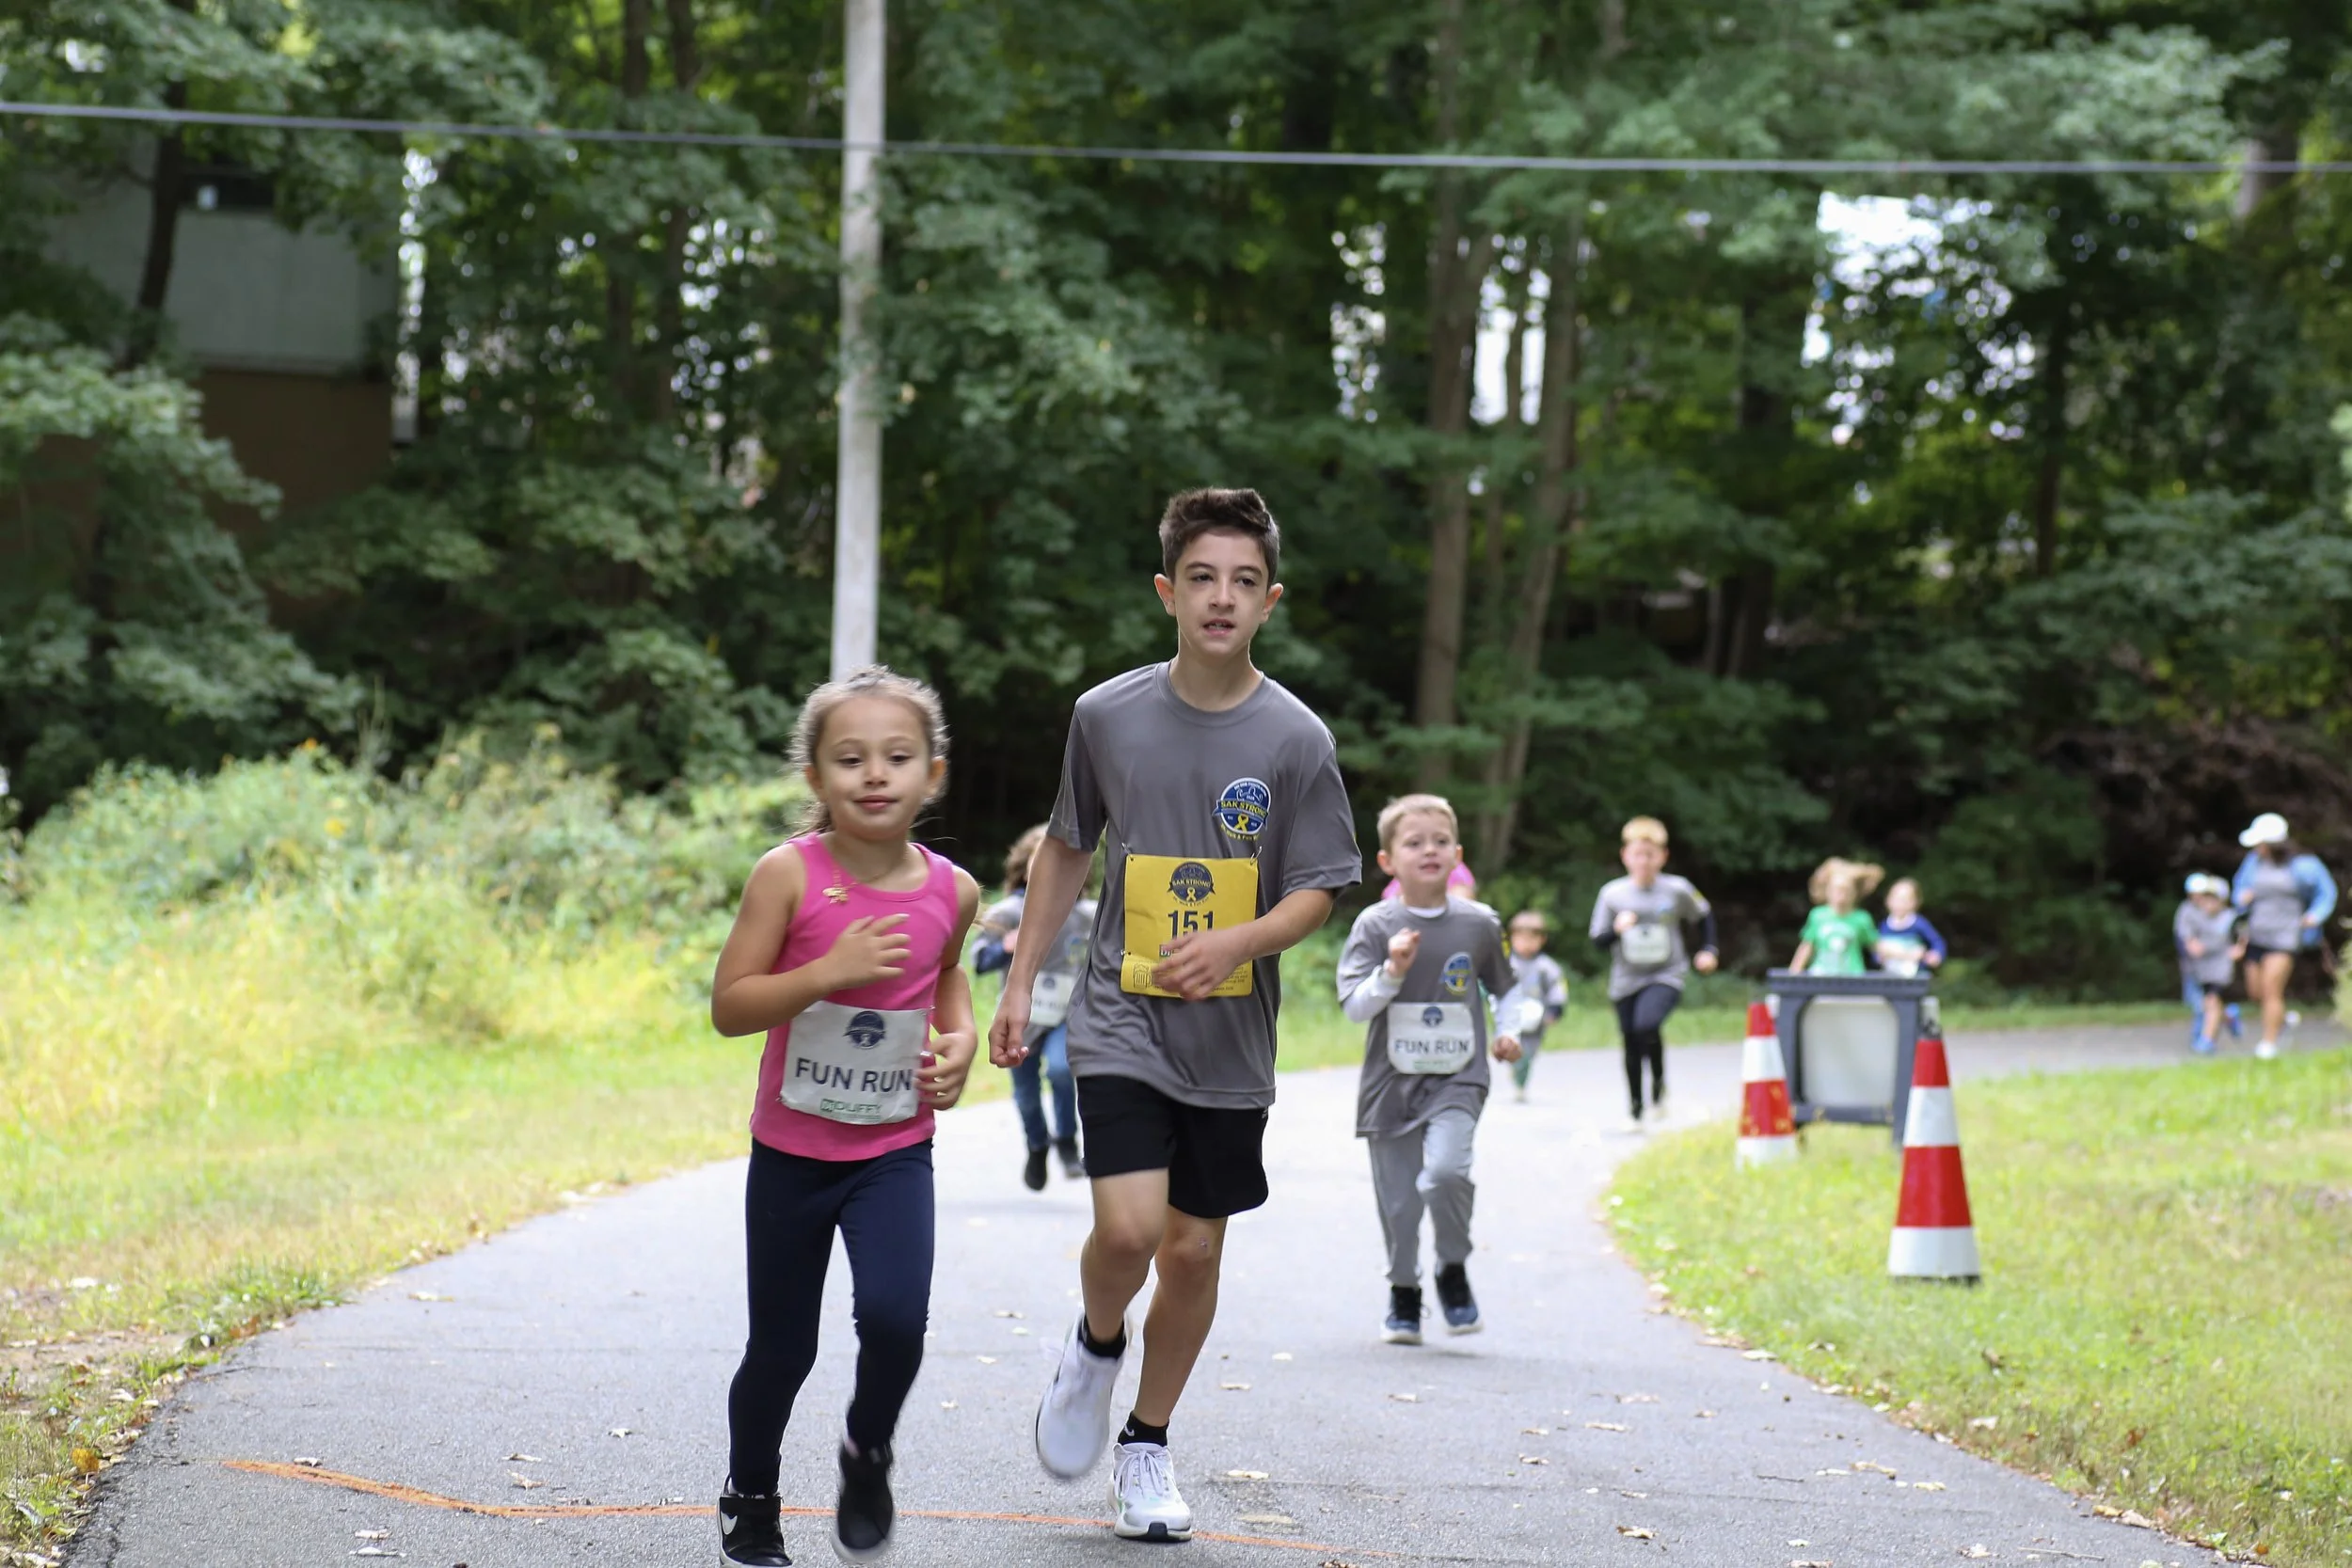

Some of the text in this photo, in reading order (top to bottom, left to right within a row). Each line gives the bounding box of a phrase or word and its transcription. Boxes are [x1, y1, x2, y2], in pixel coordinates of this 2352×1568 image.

[1221, 800, 1266, 818] SAK STRONG
[1168, 910, 1214, 940] 151
[1394, 1038, 1470, 1054] FUN RUN
[794, 1056, 914, 1093] FUN RUN
